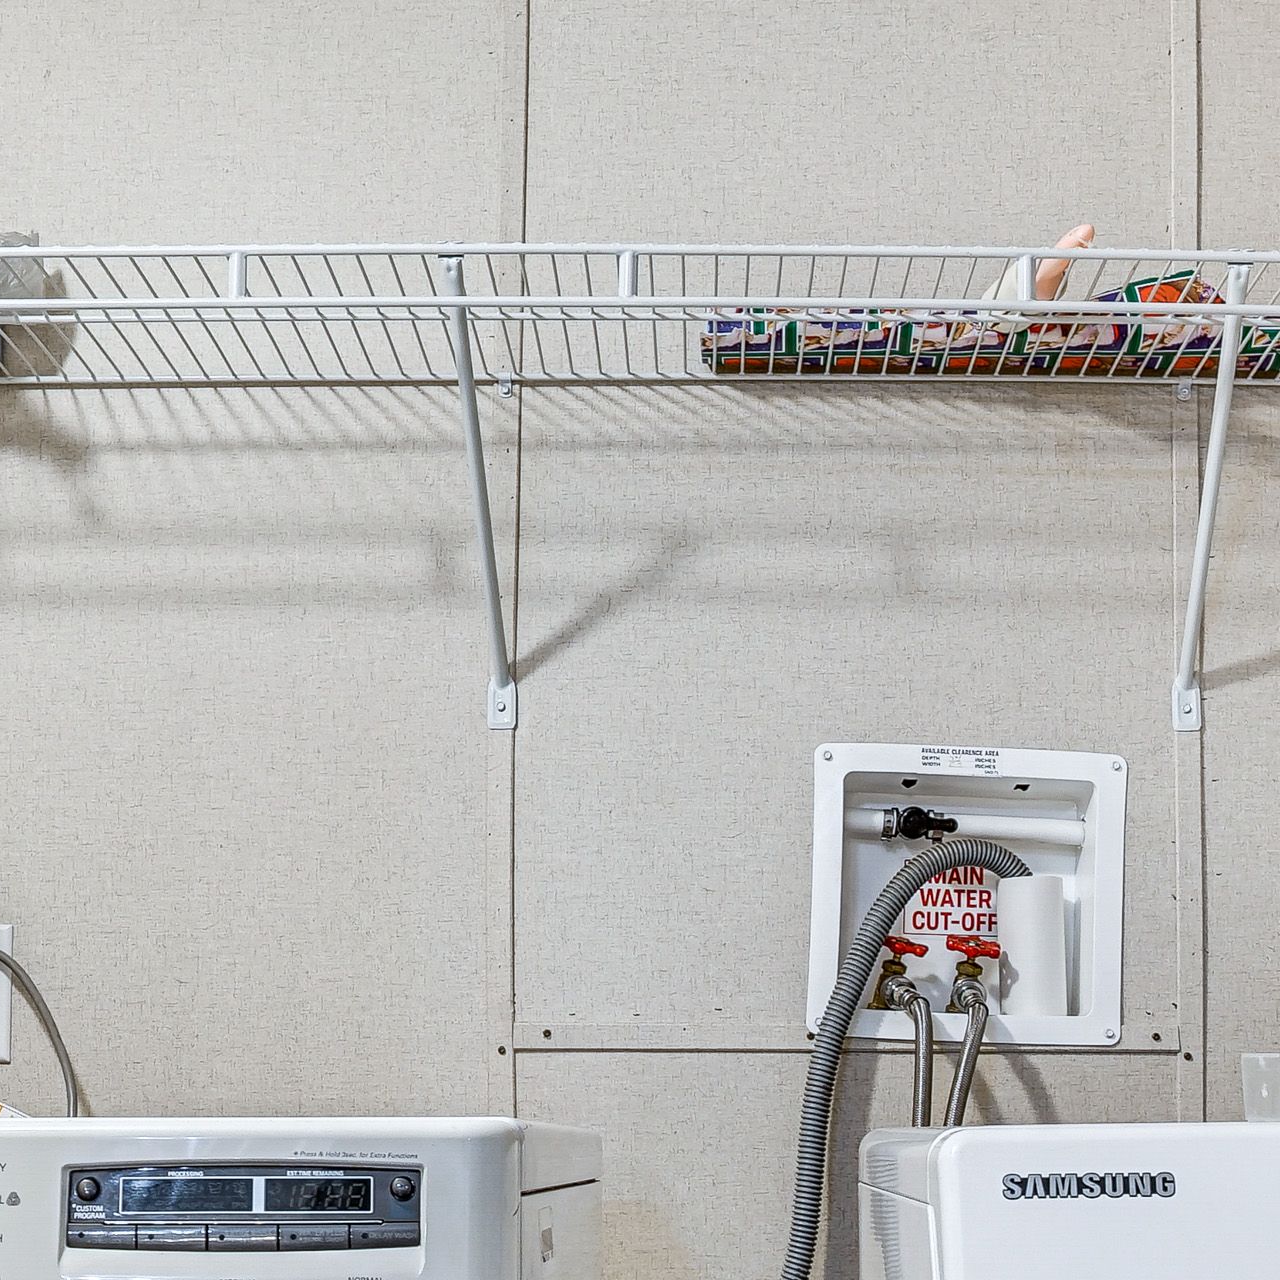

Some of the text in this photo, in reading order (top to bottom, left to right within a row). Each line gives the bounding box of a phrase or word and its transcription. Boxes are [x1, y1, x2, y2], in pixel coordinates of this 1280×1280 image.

[928, 866, 984, 885] MAIN
[920, 888, 992, 908] WATER
[912, 911, 997, 932] CUT-OFF
[1002, 1172, 1176, 1200] SAMSUNG
